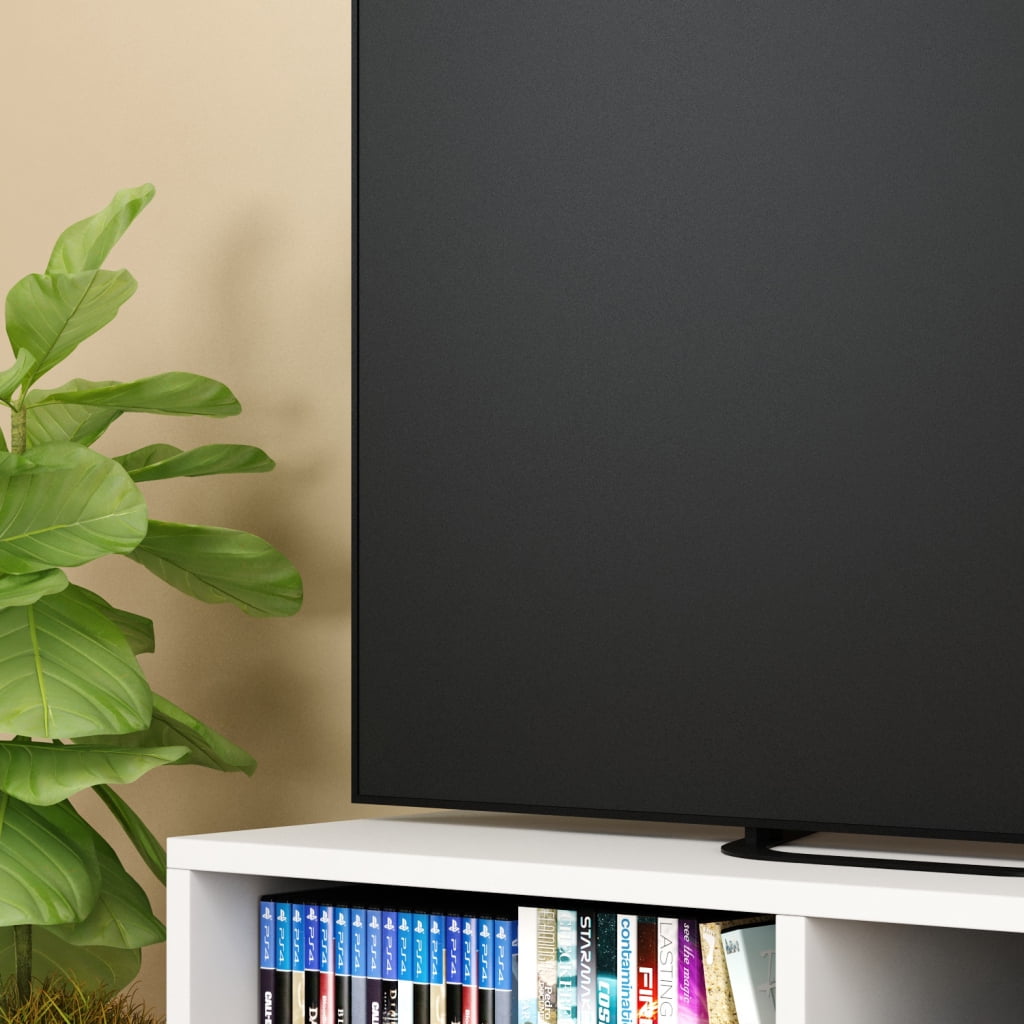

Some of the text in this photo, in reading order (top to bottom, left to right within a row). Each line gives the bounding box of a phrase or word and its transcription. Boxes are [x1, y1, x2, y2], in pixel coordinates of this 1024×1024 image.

[660, 922, 673, 1016] LASTING
[684, 944, 695, 964] the
[680, 967, 692, 1003] magic
[544, 986, 552, 1020] Pedro
